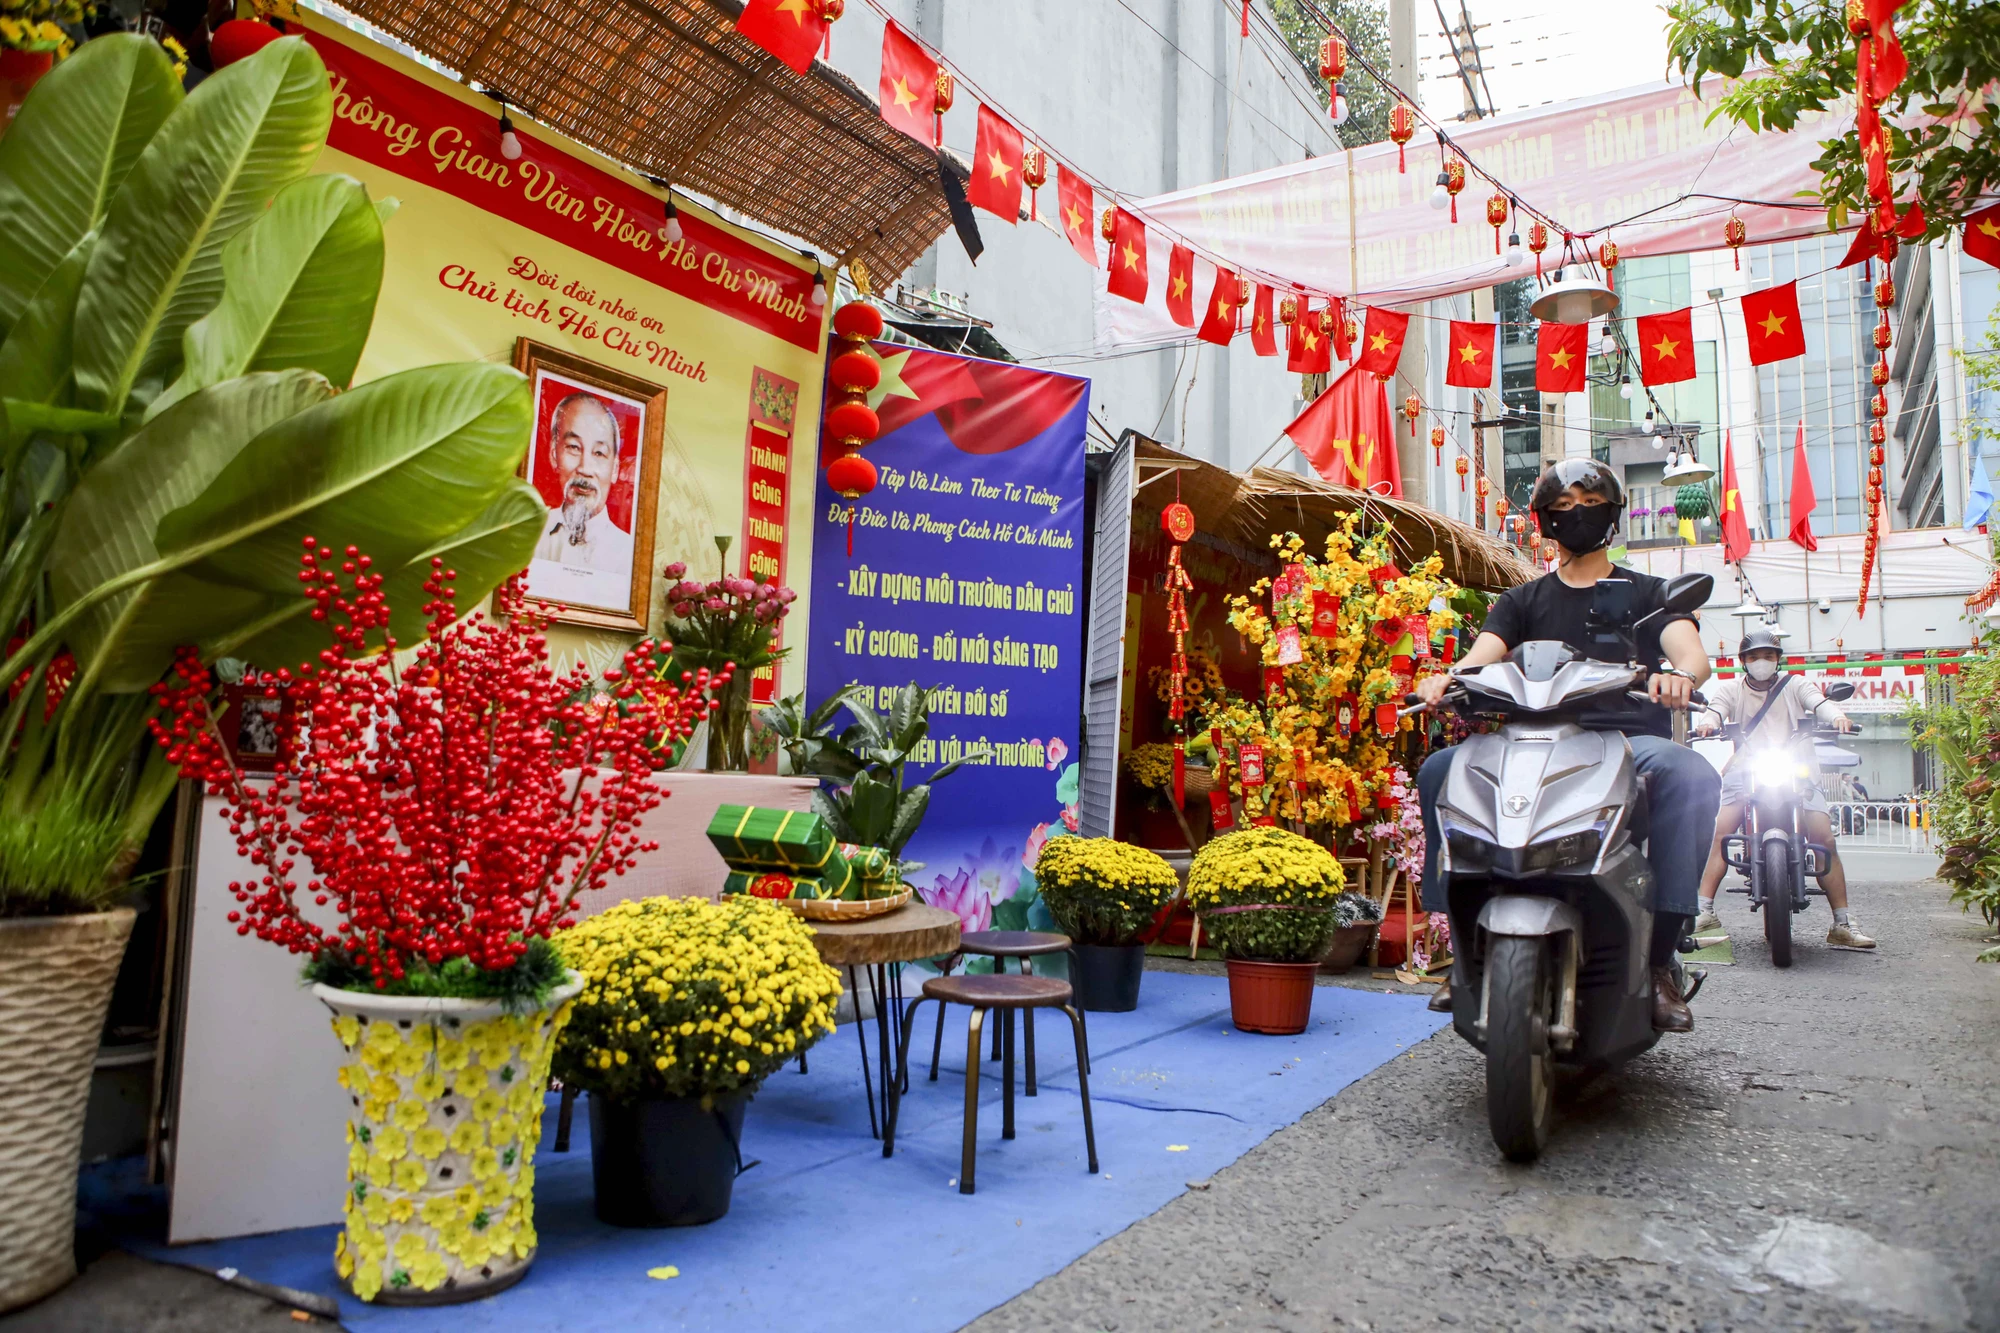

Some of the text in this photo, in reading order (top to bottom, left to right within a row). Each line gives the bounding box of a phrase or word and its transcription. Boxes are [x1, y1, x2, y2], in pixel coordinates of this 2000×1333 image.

[326, 70, 807, 323] hông Gian Văn Hóa Hồ Chí Minh
[507, 256, 665, 334] Đời đời nhớ ơn
[439, 264, 708, 383] Chủ tịch Hồ Chí Minh
[751, 445, 786, 474] THÀNH
[752, 479, 782, 507] CÔNG
[880, 466, 1062, 514] Tập Và Làm Theo Tư Tưởng
[749, 516, 783, 544] THÀNH
[859, 506, 888, 528] Đức
[891, 510, 911, 531] Và
[912, 513, 957, 543] Phong
[958, 518, 991, 540] Cách
[993, 522, 1013, 542] Hồ
[1015, 525, 1038, 545] Chí
[1038, 528, 1074, 549] Minh
[749, 550, 778, 577] CÔNG
[848, 564, 878, 597] XÂY
[881, 573, 921, 605] DỰNG
[925, 572, 954, 604] MÔI
[958, 576, 1012, 610] TRƯỜNG
[1016, 581, 1043, 612] DÂN
[1047, 583, 1073, 615] CHỦ
[845, 621, 865, 655] KỶ
[869, 630, 918, 659] CƯƠNG
[933, 630, 957, 662] ĐỔI
[961, 632, 989, 664] MỚI
[993, 635, 1029, 667] SÁNG
[1033, 643, 1058, 673] TẠO
[753, 665, 773, 680] NG
[878, 685, 905, 715] CỰ
[921, 684, 962, 714] UYỂN
[965, 686, 987, 716] ĐỔI
[990, 689, 1009, 717] SỐ
[1853, 680, 1914, 699] KHAI
[940, 734, 961, 764] VỚI
[995, 737, 1045, 767] TRƯỜNG
